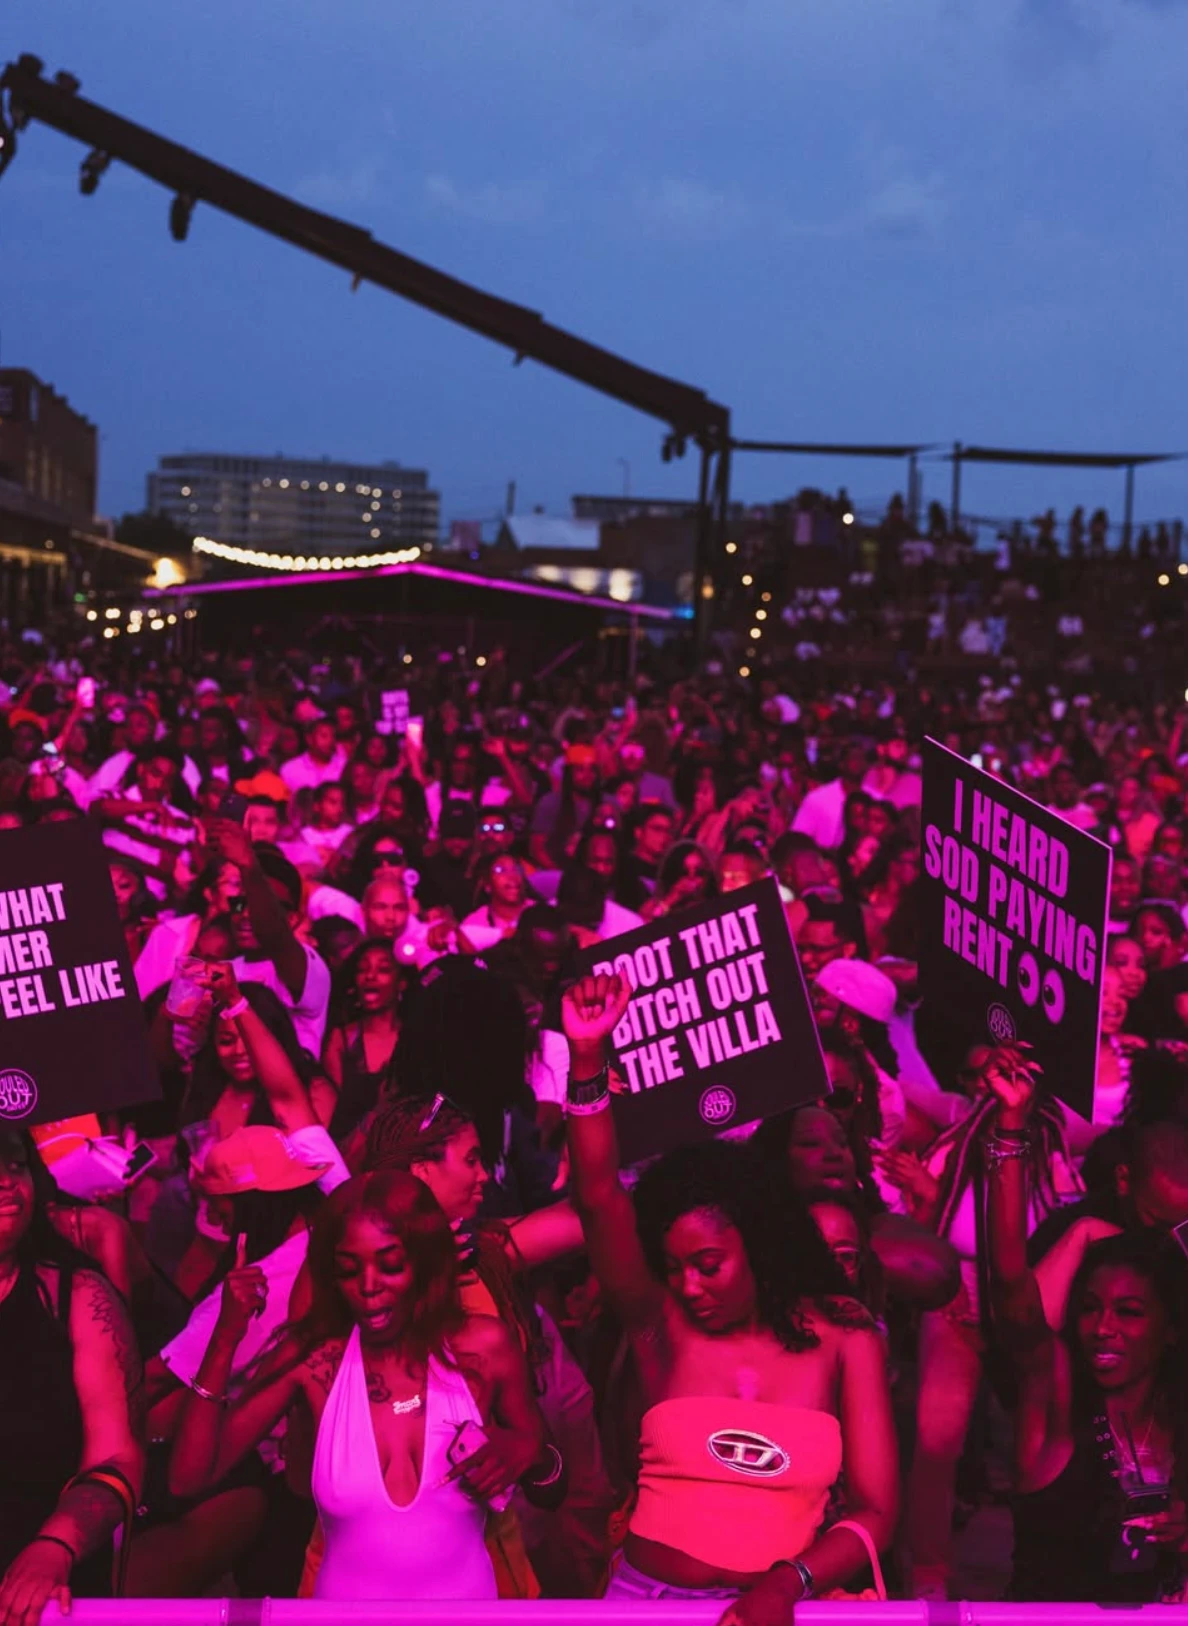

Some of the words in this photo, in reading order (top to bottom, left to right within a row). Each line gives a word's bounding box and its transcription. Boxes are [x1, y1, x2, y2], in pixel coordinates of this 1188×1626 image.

[954, 778, 963, 833] I
[972, 790, 1069, 898] HEARD
[593, 937, 674, 993] OOT
[679, 904, 761, 970] THAT
[925, 824, 979, 903] SOD
[988, 864, 1097, 985] PAYING
[944, 896, 1013, 988] RENT
[0, 975, 56, 1019] EEL
[58, 960, 125, 1007] LIKE
[612, 978, 702, 1049] BITCH
[706, 952, 769, 1010] OUT
[619, 1036, 684, 1094] THE
[686, 1001, 782, 1069] VILLA
